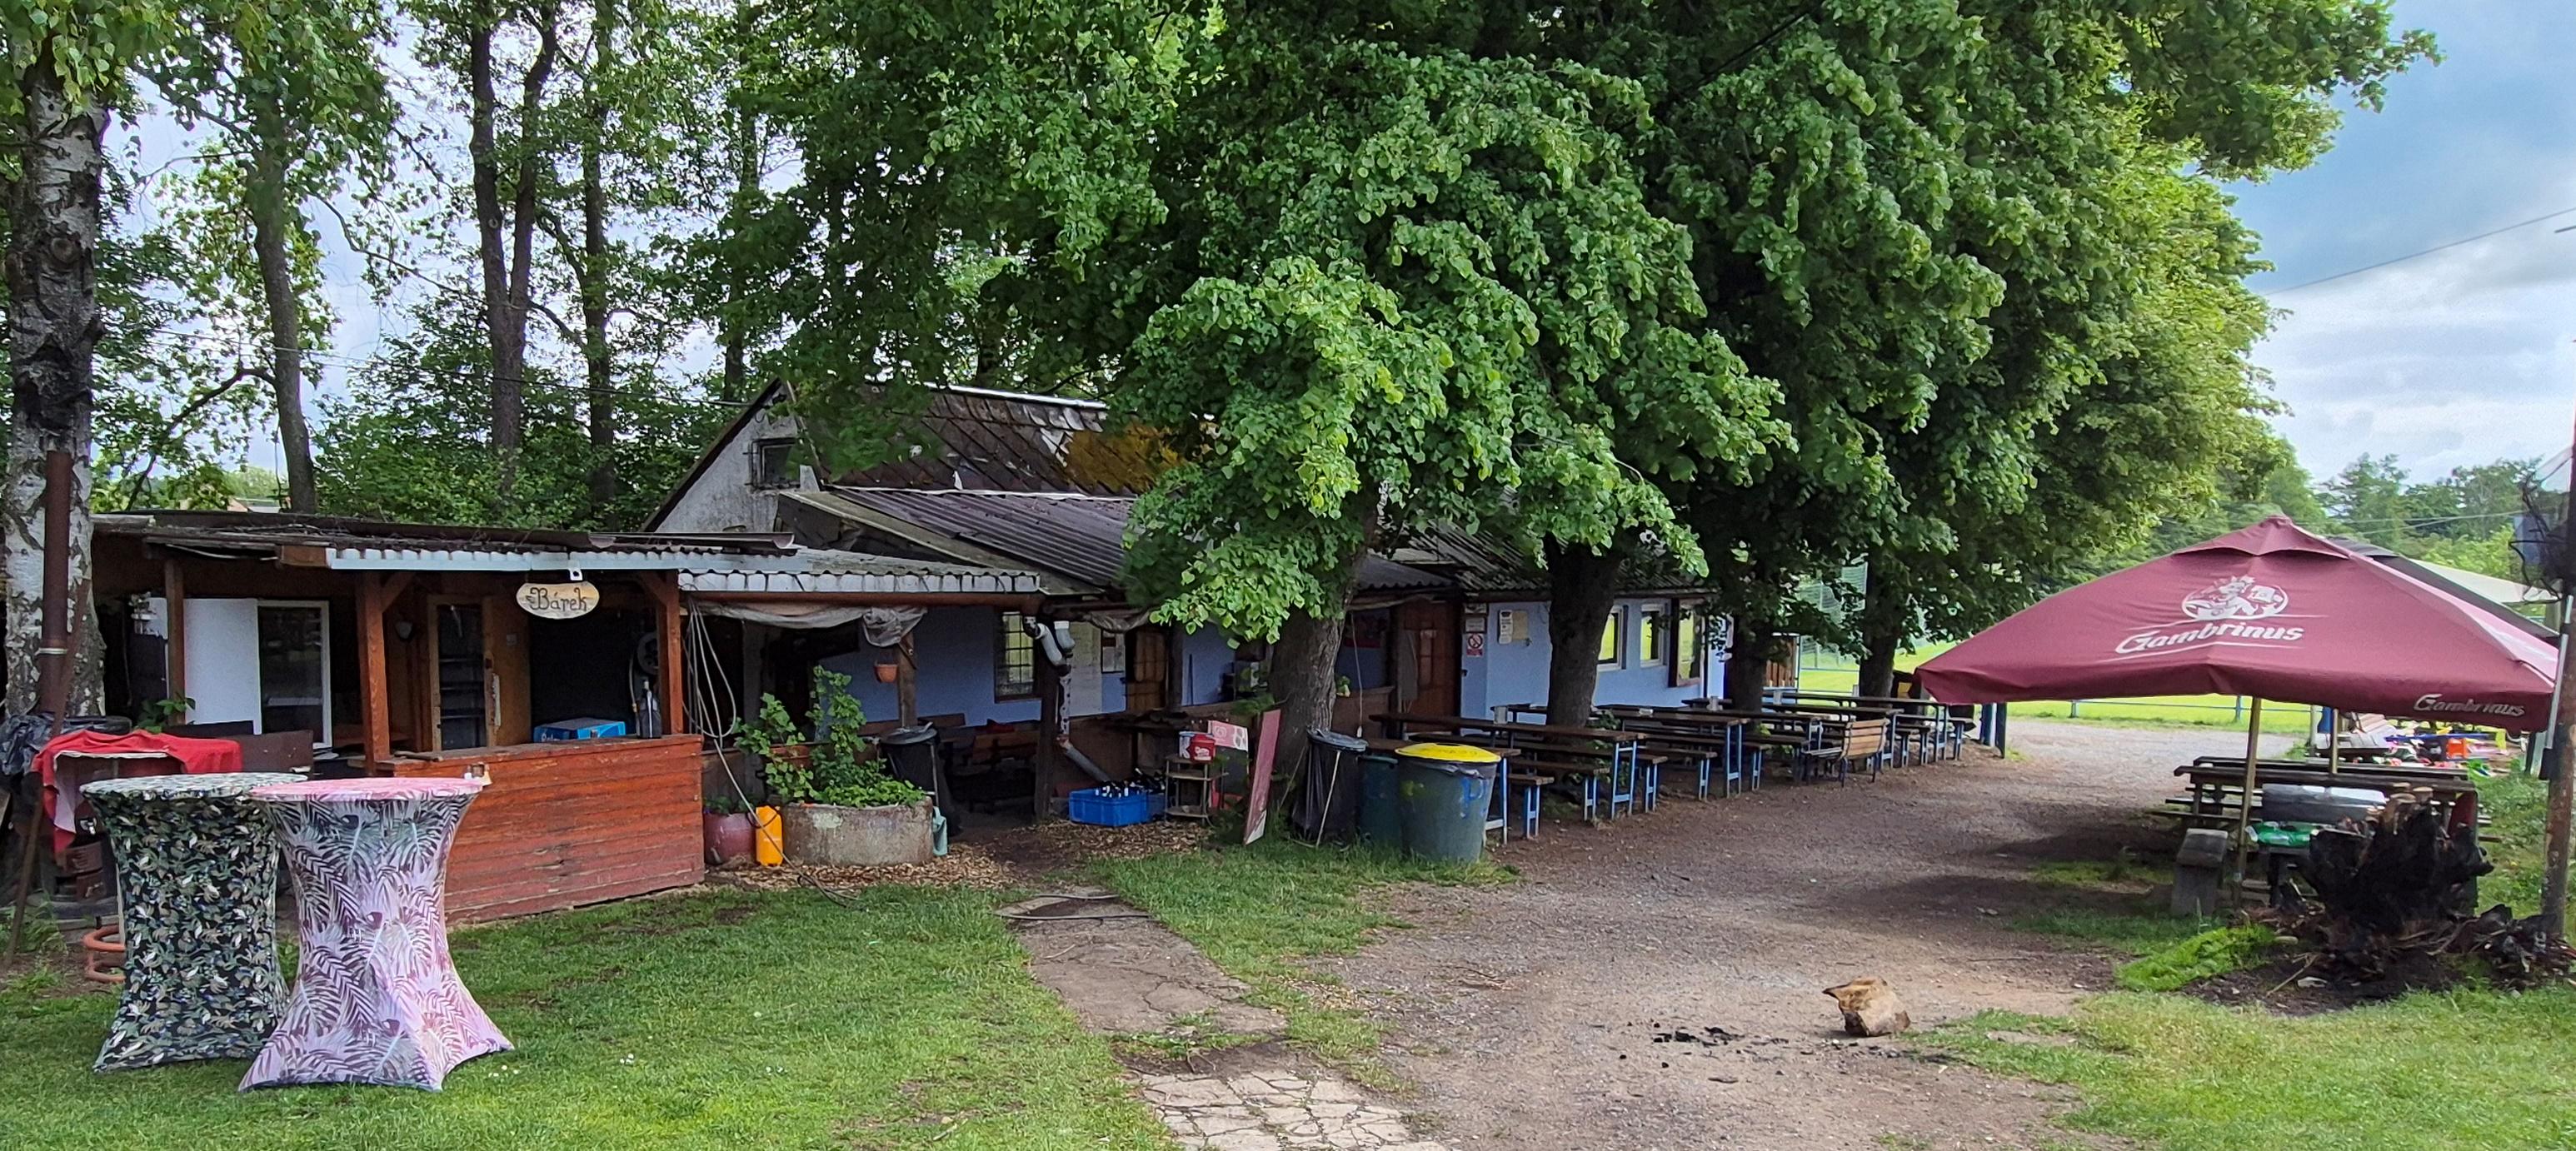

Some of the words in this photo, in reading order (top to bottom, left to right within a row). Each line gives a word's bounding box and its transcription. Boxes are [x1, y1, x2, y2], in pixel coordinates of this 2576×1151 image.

[526, 587, 587, 611] Bárek
[2115, 622, 2304, 654] Gambrinus
[2414, 693, 2525, 716] Gambrinus
